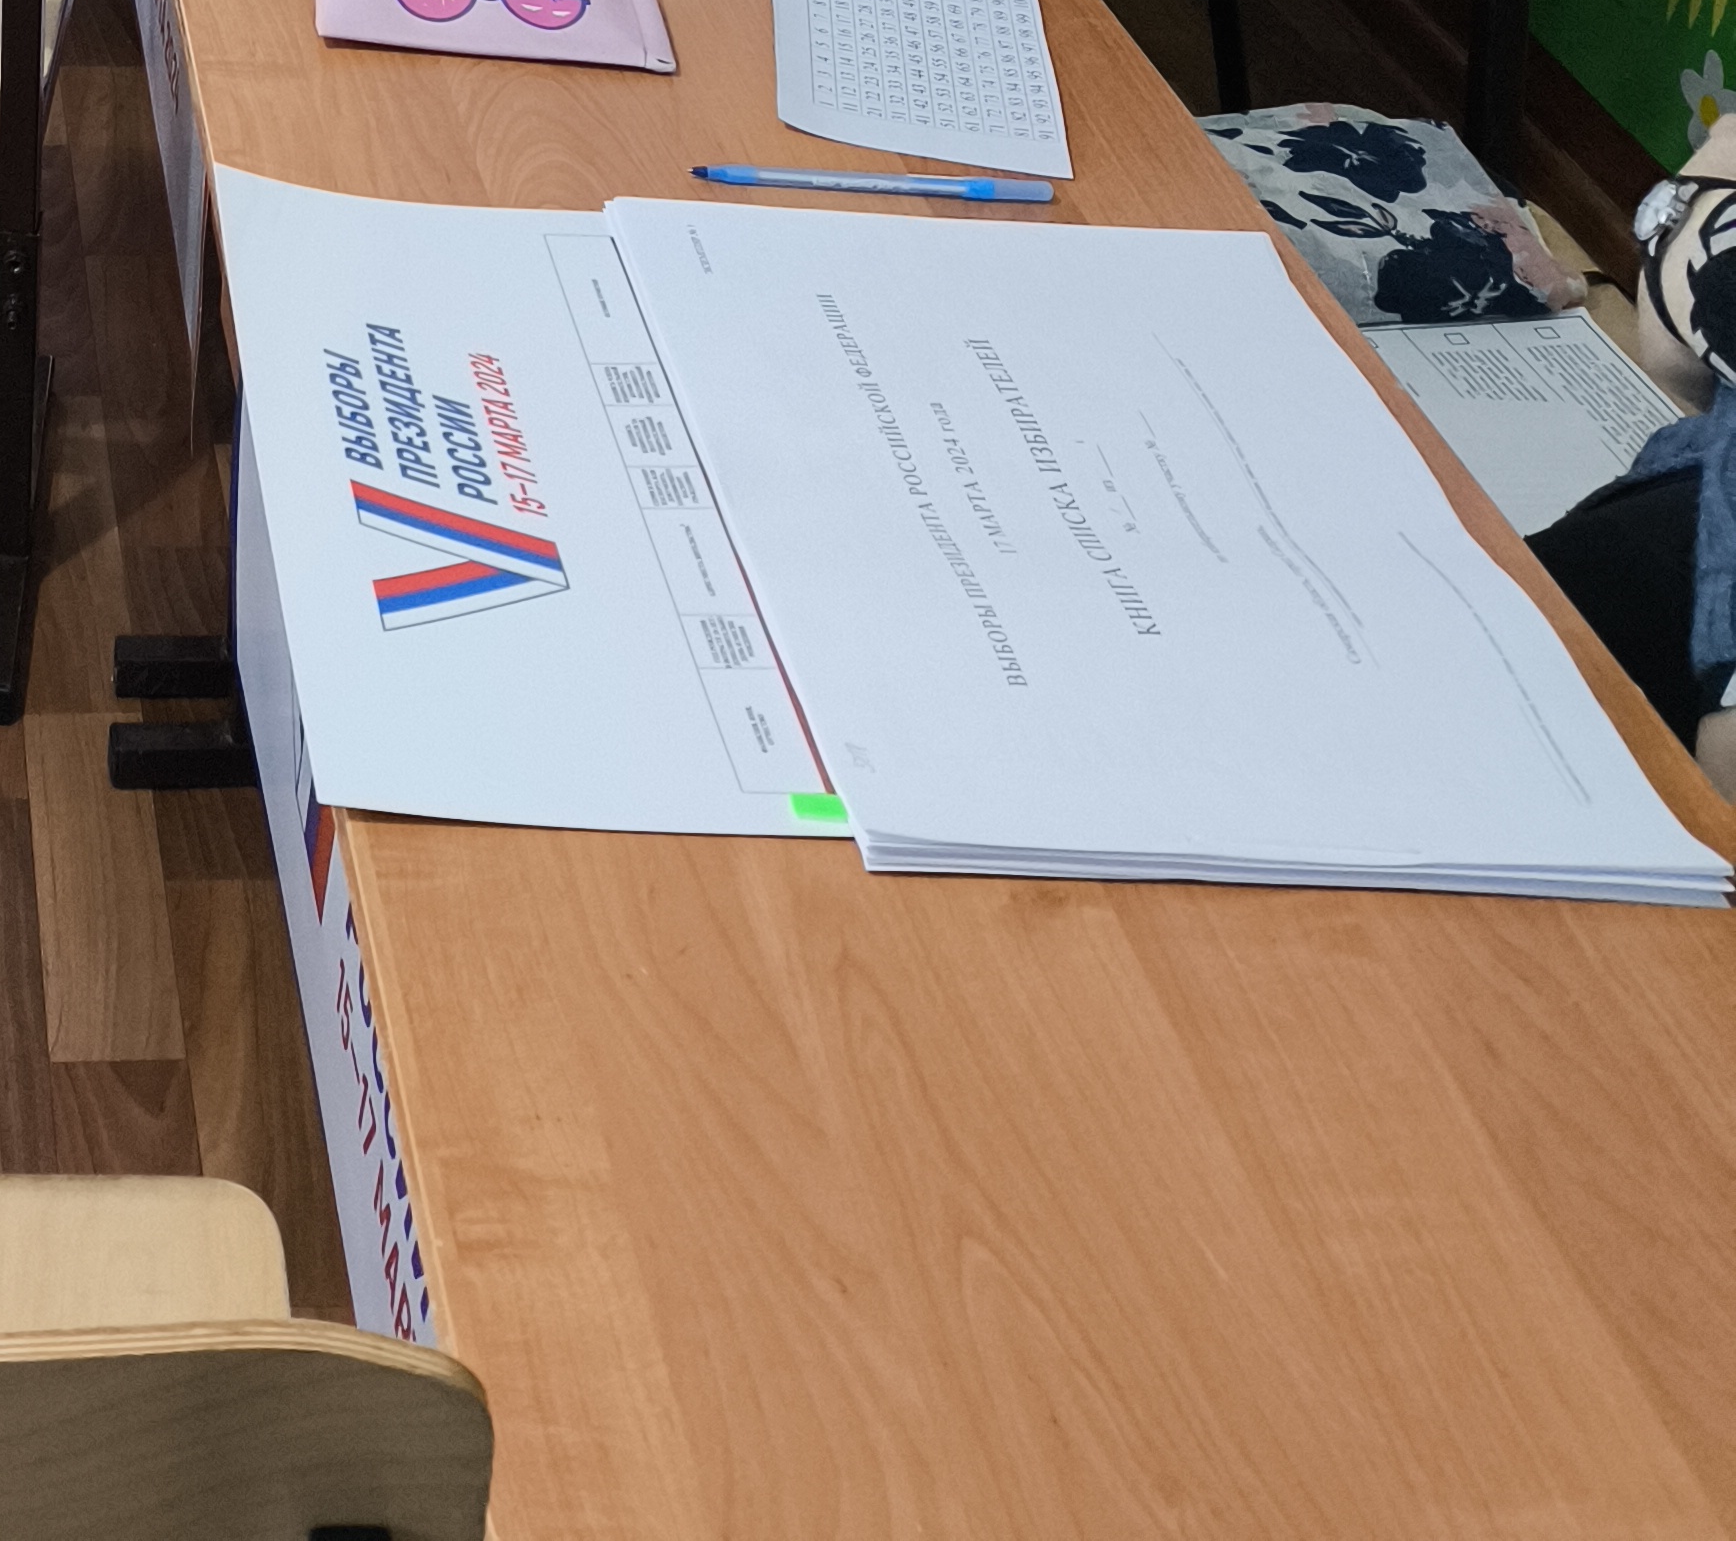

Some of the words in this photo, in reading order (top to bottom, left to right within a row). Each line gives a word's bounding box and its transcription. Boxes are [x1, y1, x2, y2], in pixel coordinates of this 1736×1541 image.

[468, 352, 511, 397] 2024
[816, 294, 872, 377] ФЕДЕРАЦИИ
[323, 348, 384, 470] ВЫБОРЫ
[366, 323, 441, 489] ПРЕЗИДЕНТА
[481, 398, 531, 463] МАРТА
[858, 382, 928, 496] РОССИЙСКОЙ
[963, 338, 1062, 473] ИЗБИРАТЕЛЕЙ
[432, 394, 498, 505] РОССИИ
[944, 438, 974, 475] 2024
[918, 502, 988, 599] ПРЕЗИДЕНТА
[964, 481, 1006, 537] МАРТА
[1049, 482, 1113, 562] СПИСКА
[1102, 567, 1161, 636] КНИГА
[973, 604, 1028, 687] ВЫБОРЫ
